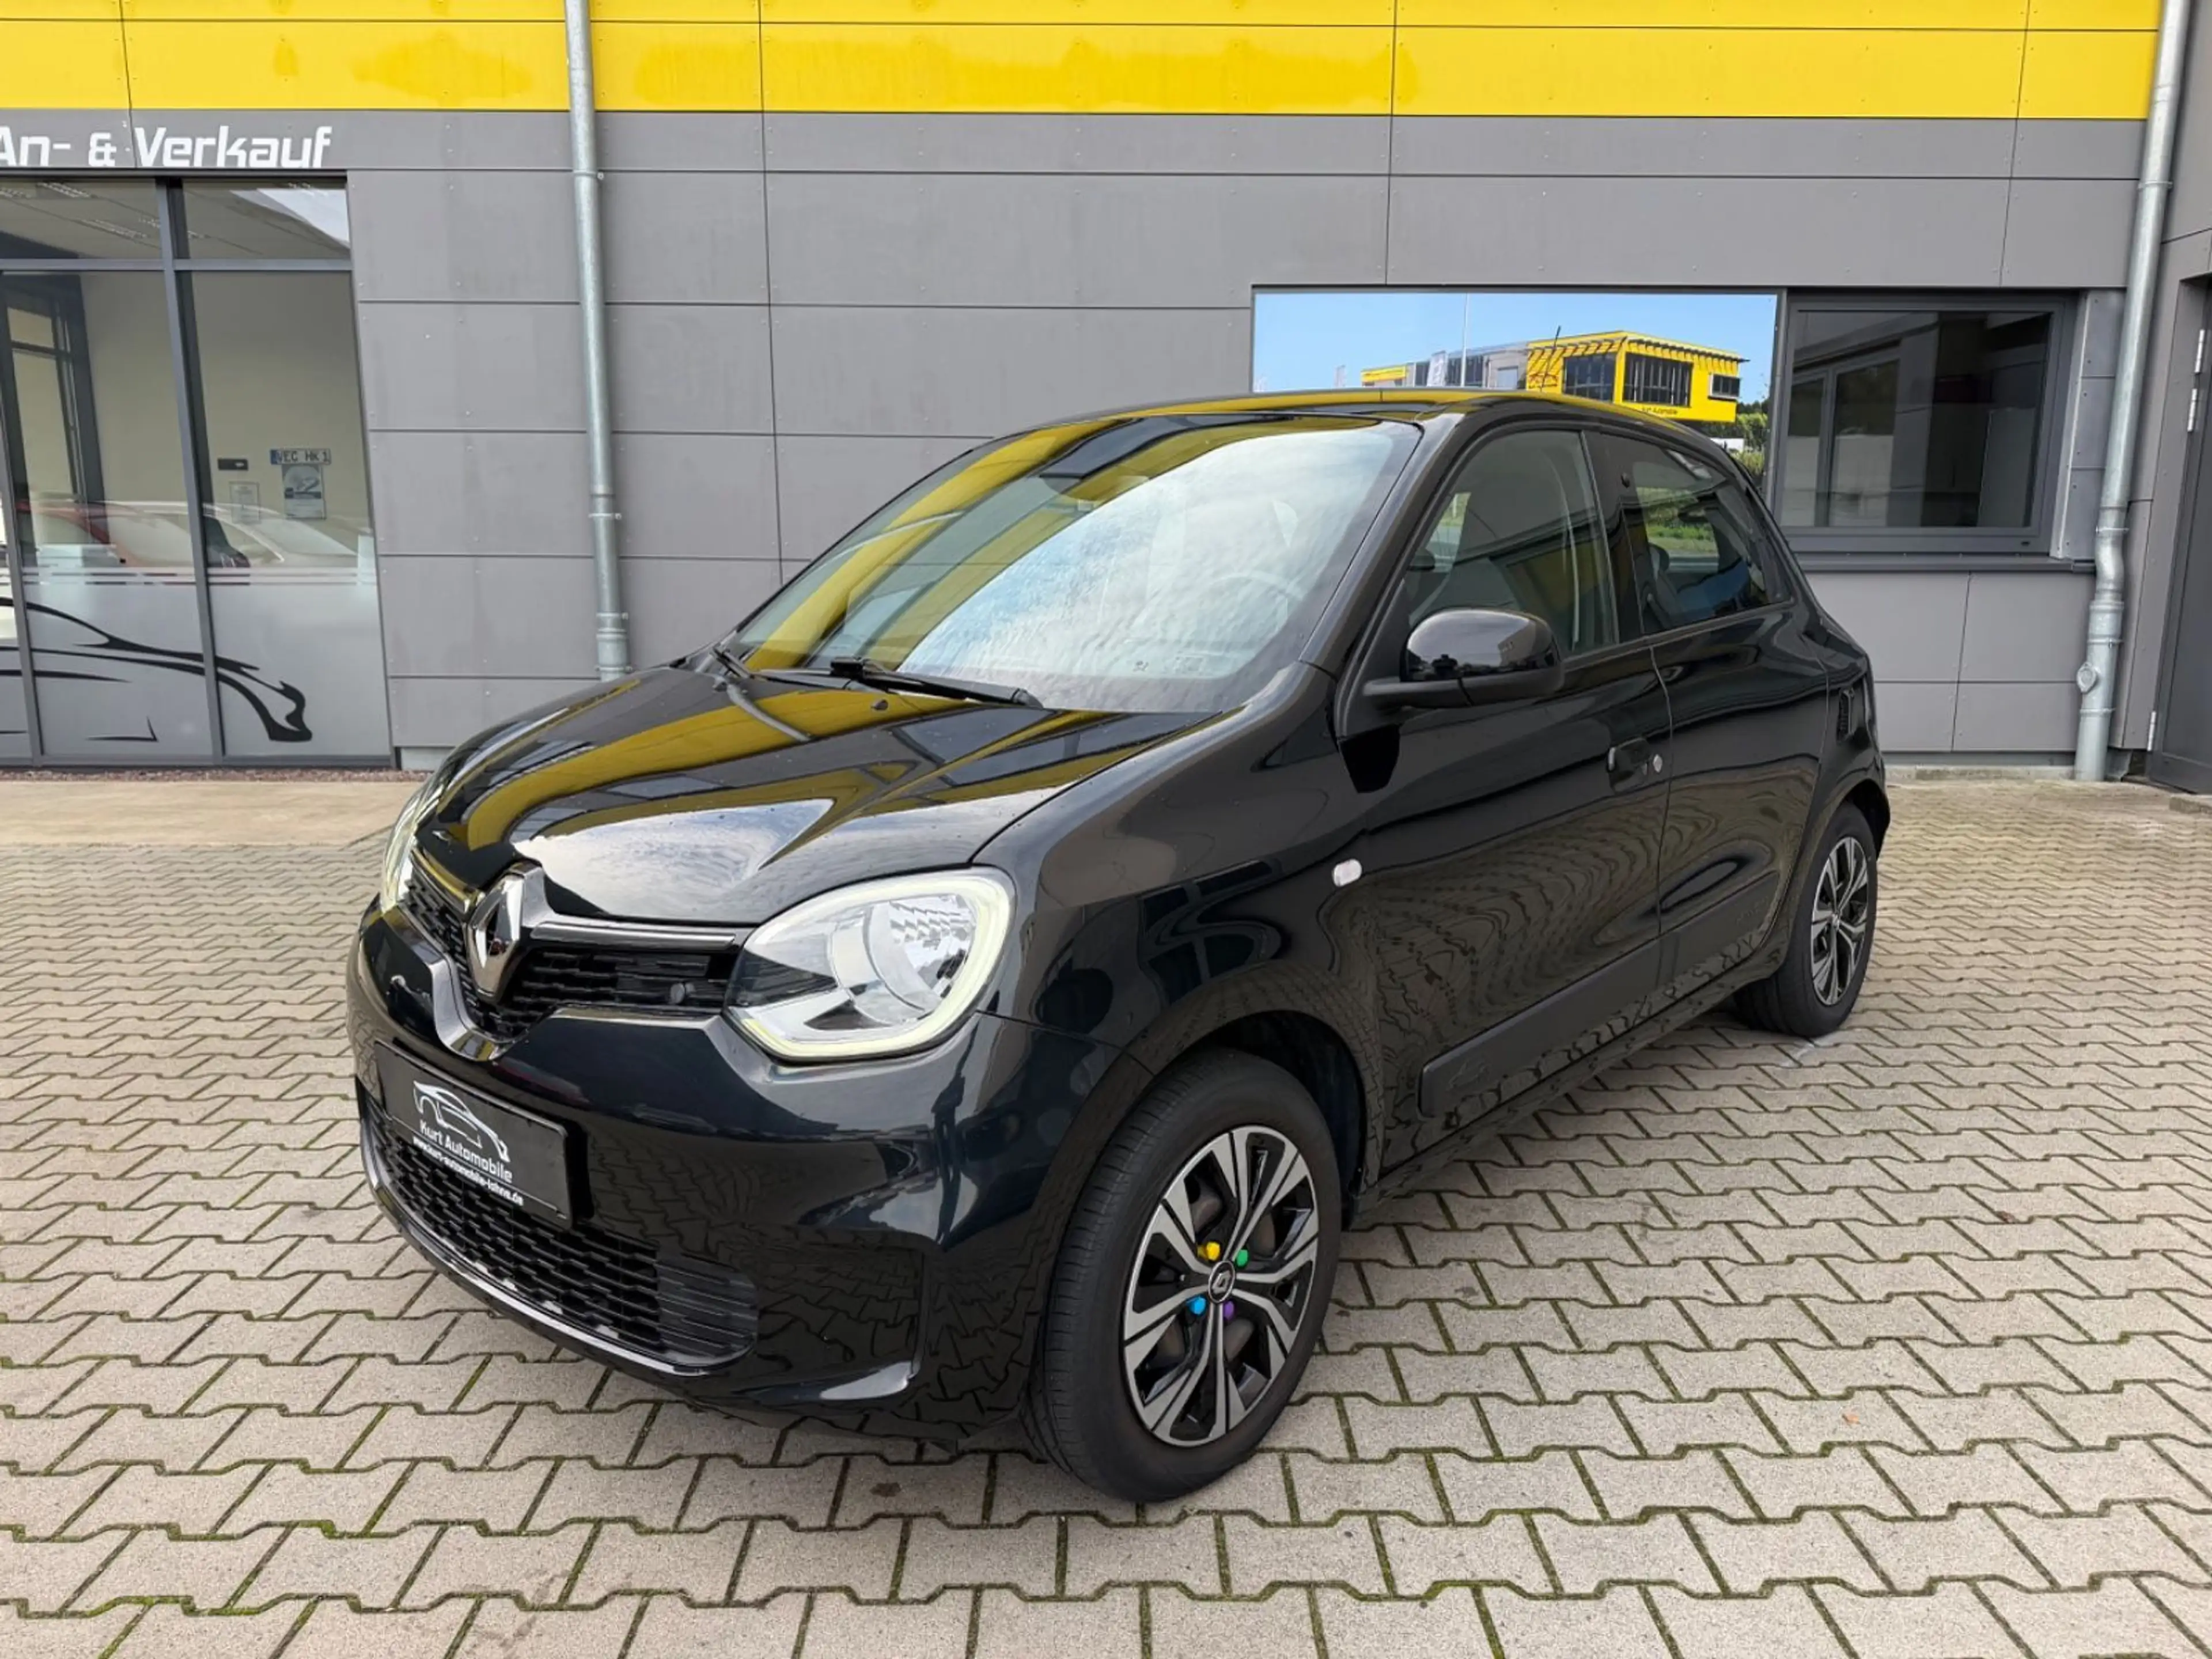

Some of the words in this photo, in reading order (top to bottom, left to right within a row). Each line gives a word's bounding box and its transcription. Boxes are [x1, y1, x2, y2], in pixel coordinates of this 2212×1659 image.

[0, 126, 71, 166] An-
[88, 132, 117, 167] &
[135, 125, 333, 168] Verkauf
[445, 1135, 513, 1183] Automobile
